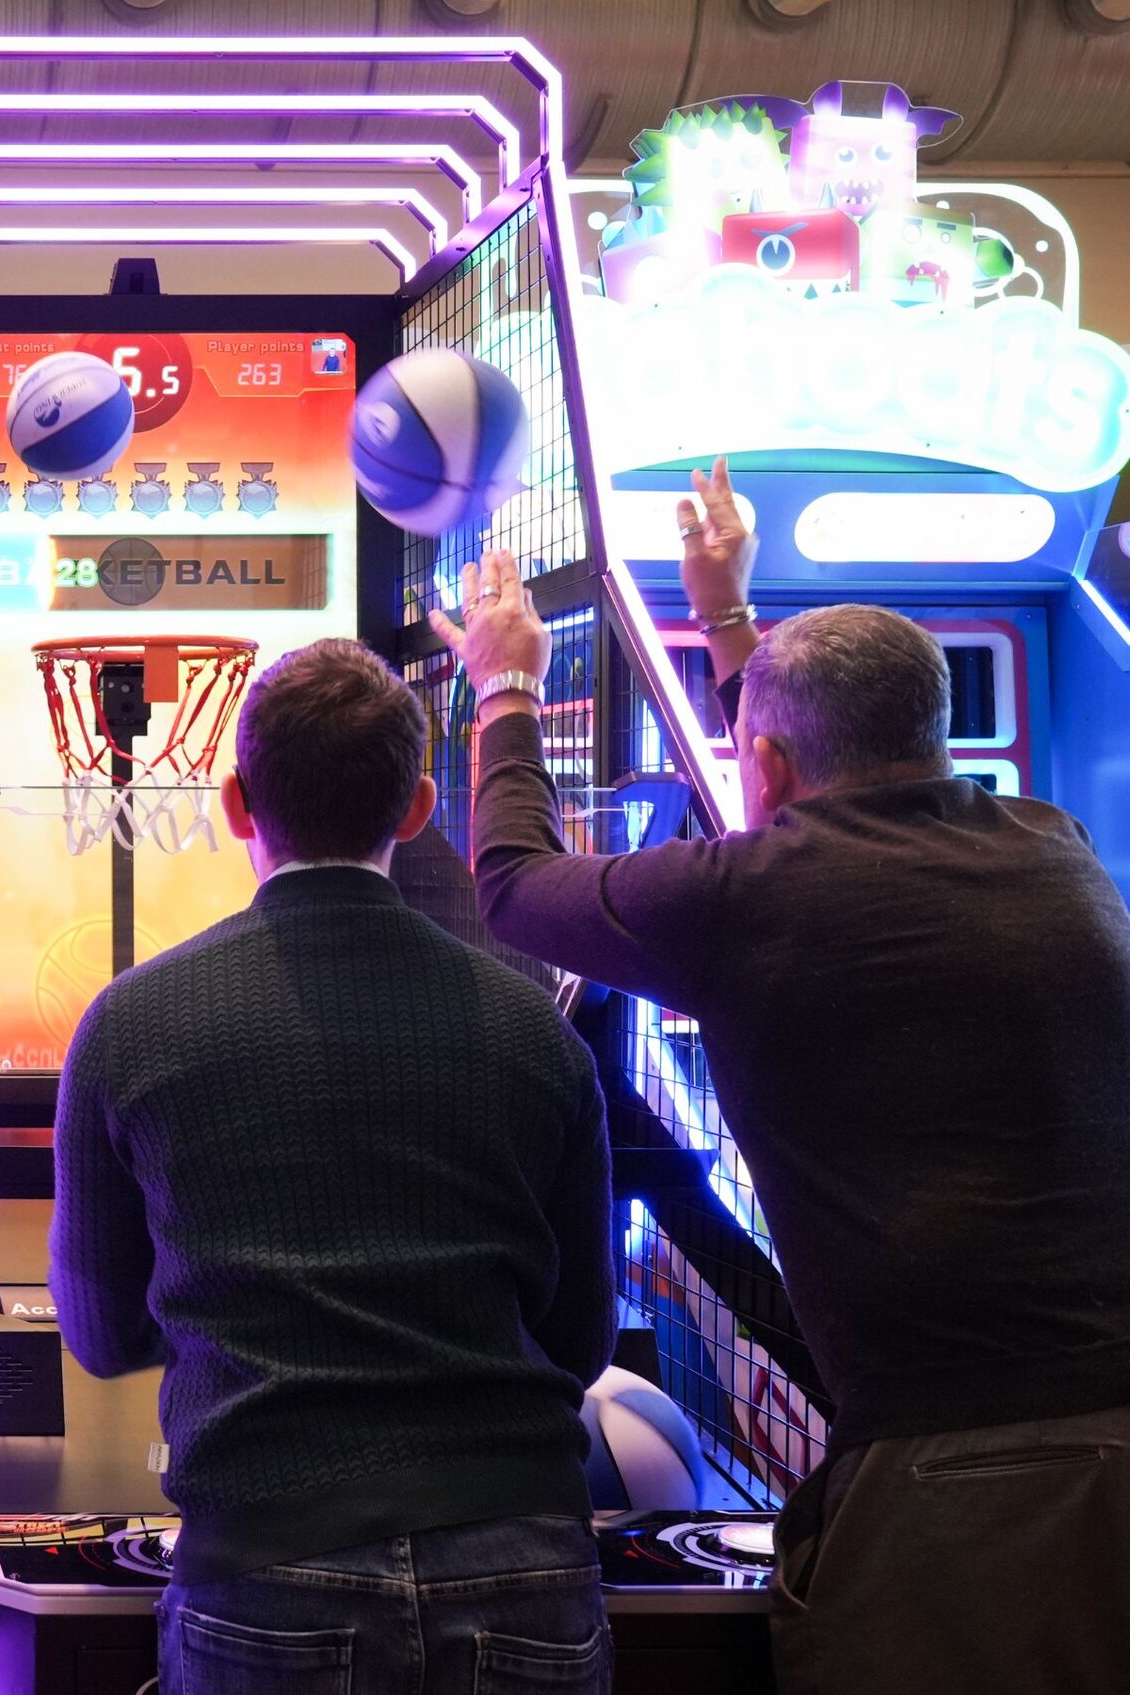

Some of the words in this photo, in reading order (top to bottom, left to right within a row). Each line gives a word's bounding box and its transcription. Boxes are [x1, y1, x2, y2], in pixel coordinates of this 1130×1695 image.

[15, 343, 55, 354] points
[207, 341, 255, 356] Player
[260, 342, 304, 354] points
[237, 363, 282, 386] 263
[55, 557, 99, 588] 28
